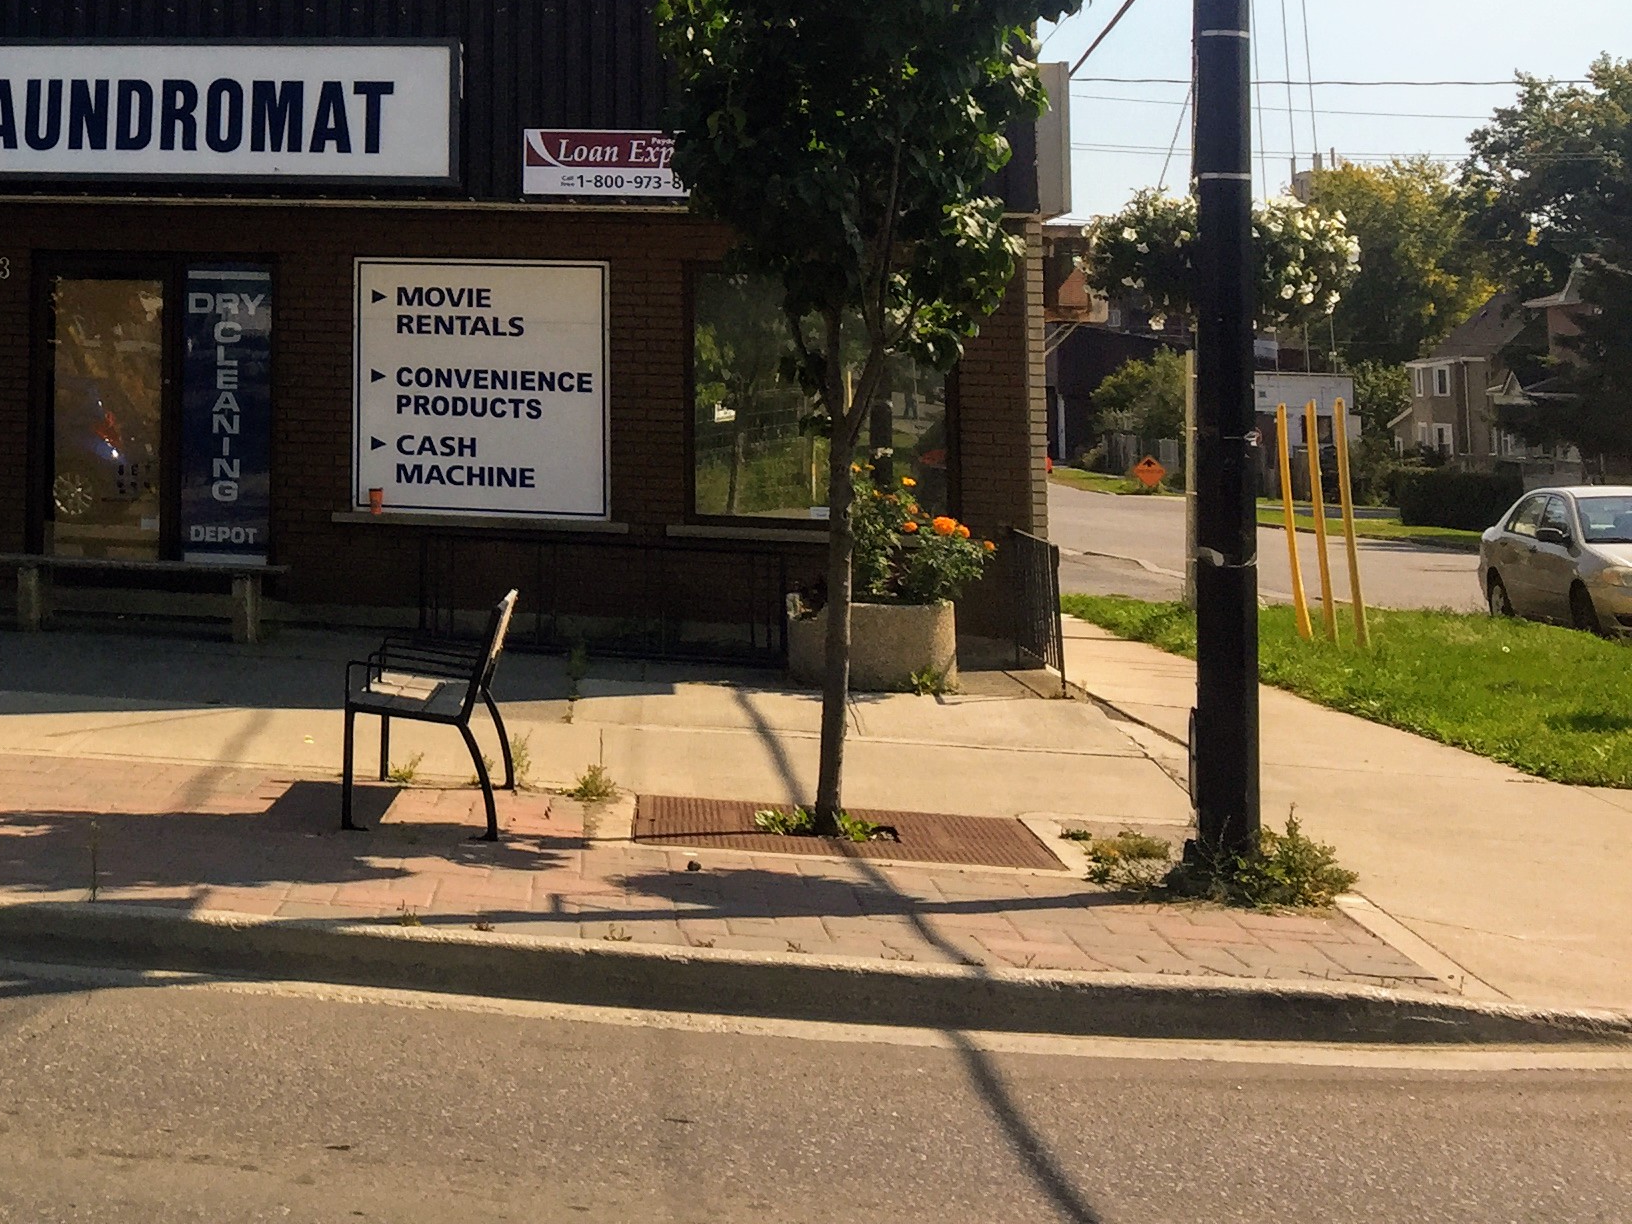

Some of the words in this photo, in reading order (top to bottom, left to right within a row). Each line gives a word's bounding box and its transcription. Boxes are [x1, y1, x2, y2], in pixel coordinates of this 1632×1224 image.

[557, 139, 618, 163] Loan
[576, 175, 682, 190] 1-800-973-8
[188, 292, 265, 315] DRY
[396, 286, 492, 308] MOVIE
[396, 314, 525, 337] RENTALS
[396, 366, 593, 393] CONVENIENCE
[212, 321, 242, 502] CLEANING
[396, 394, 543, 420] PRODUCTS
[396, 434, 477, 458] CASH
[395, 463, 536, 488] MACHINE
[190, 525, 257, 544] DEPOT
